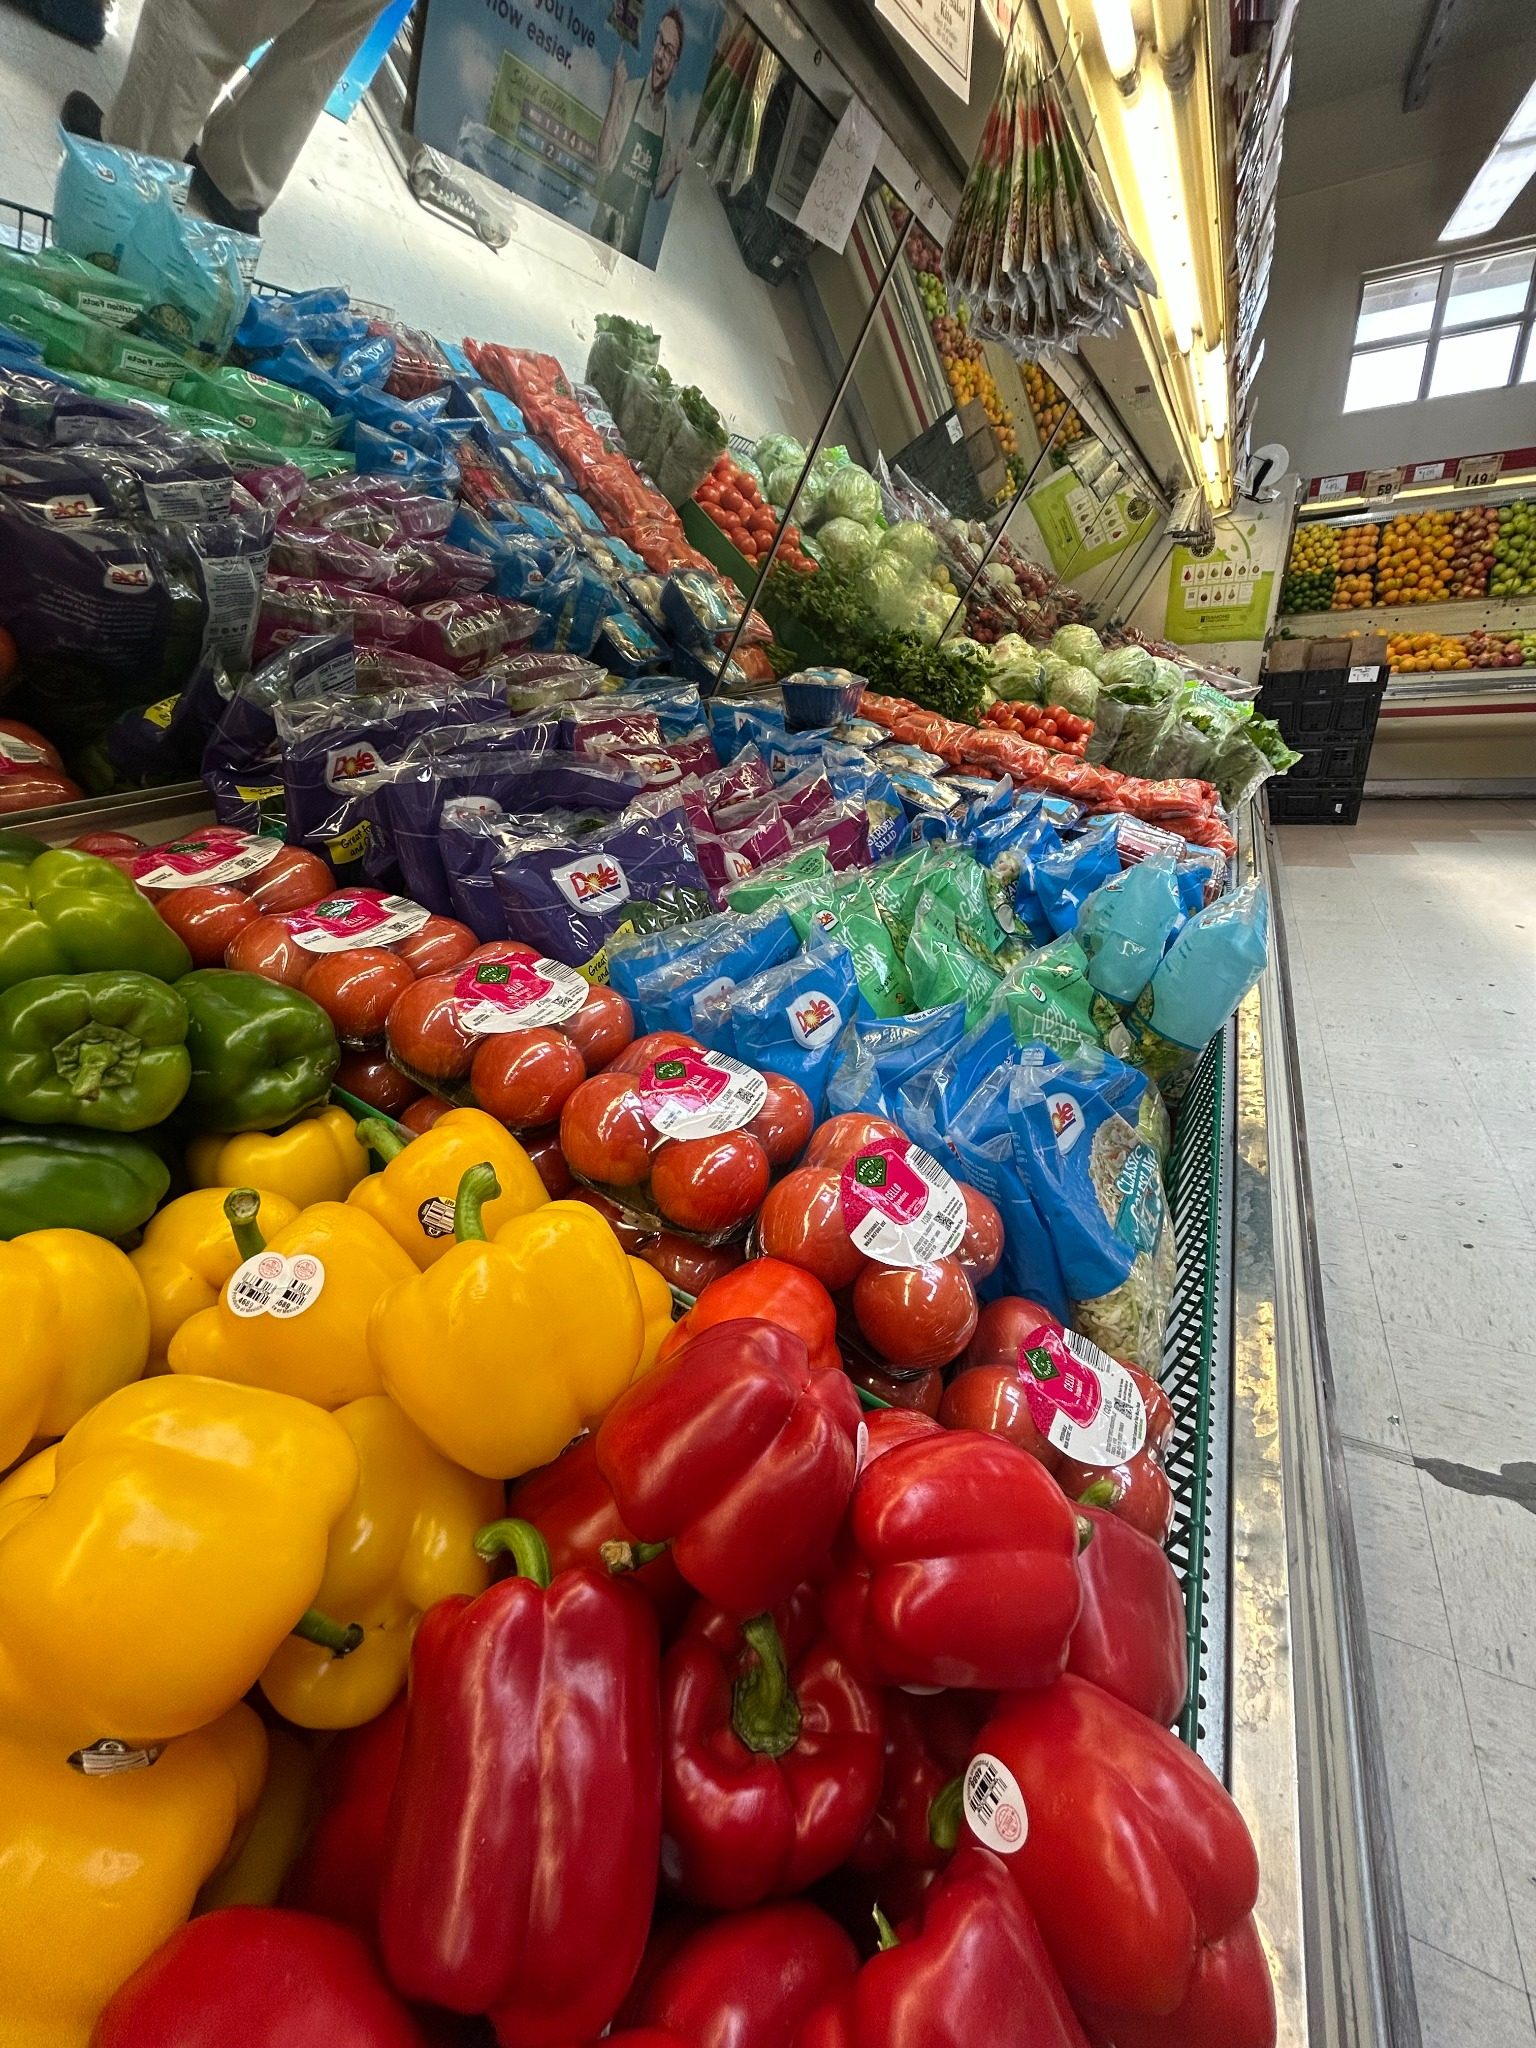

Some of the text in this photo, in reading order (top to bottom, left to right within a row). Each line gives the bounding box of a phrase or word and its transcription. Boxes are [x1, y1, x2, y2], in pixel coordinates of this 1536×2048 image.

[566, 6, 596, 49] love
[526, 22, 573, 70] easier.
[1465, 473, 1488, 487] 149
[333, 748, 377, 780] Dole
[341, 829, 363, 850] Great
[350, 845, 364, 857] and
[874, 829, 898, 853] SALAD
[568, 862, 621, 900] Dole
[587, 952, 608, 977] Great
[795, 1000, 834, 1034] Dole
[1052, 1102, 1077, 1134] ole
[858, 1158, 876, 1177] BASKET
[867, 1167, 884, 1185] BUSHEL
[1117, 1145, 1143, 1196] CLASSIC
[884, 1182, 902, 1201] CELLO
[238, 1297, 254, 1309] 4689
